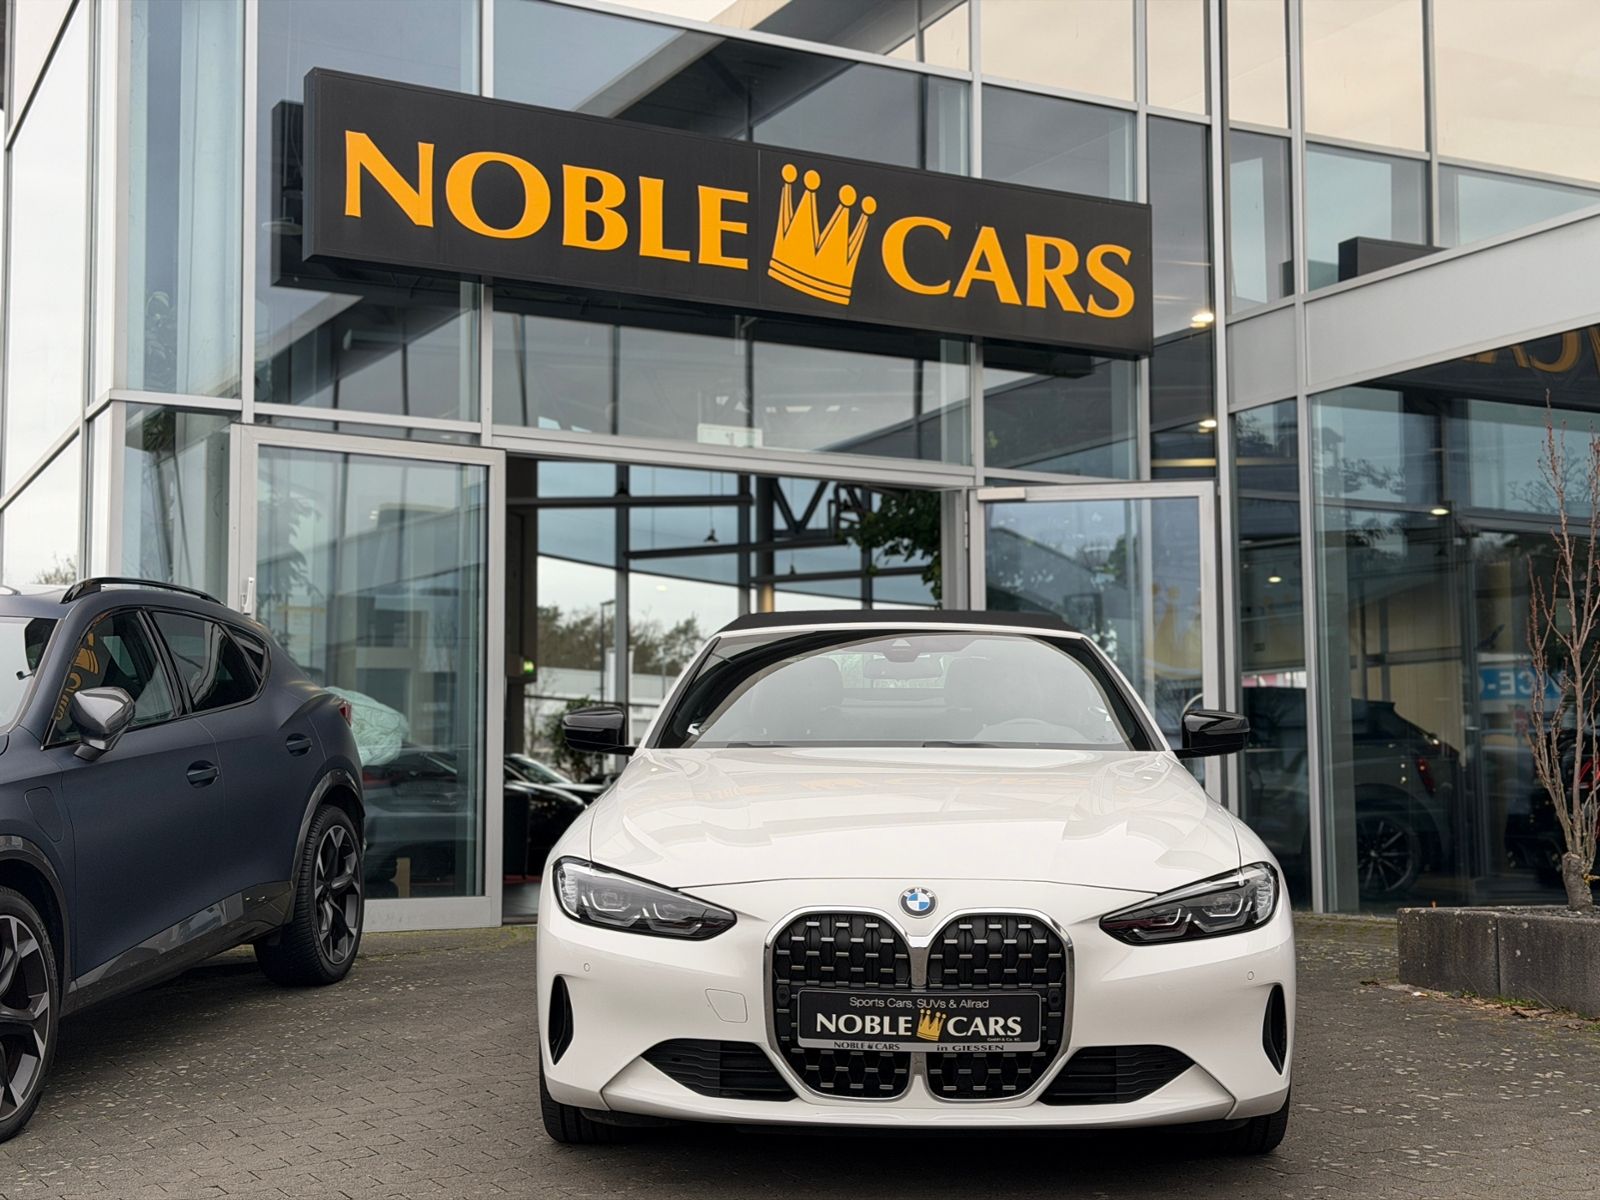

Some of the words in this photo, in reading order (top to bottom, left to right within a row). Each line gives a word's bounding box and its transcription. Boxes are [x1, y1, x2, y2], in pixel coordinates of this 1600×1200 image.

[344, 130, 750, 271] NOBLE
[881, 216, 1135, 318] CARS
[849, 997, 885, 1008] Sports
[917, 998, 946, 1009] SUVs
[948, 999, 957, 1009] &
[959, 999, 990, 1009] Allrad
[815, 1012, 913, 1036] NOBLE
[946, 1015, 1022, 1037] CARS
[833, 1041, 865, 1050] NOBLE
[874, 1043, 901, 1051] CARS
[952, 1044, 1005, 1052] GIESSEN
